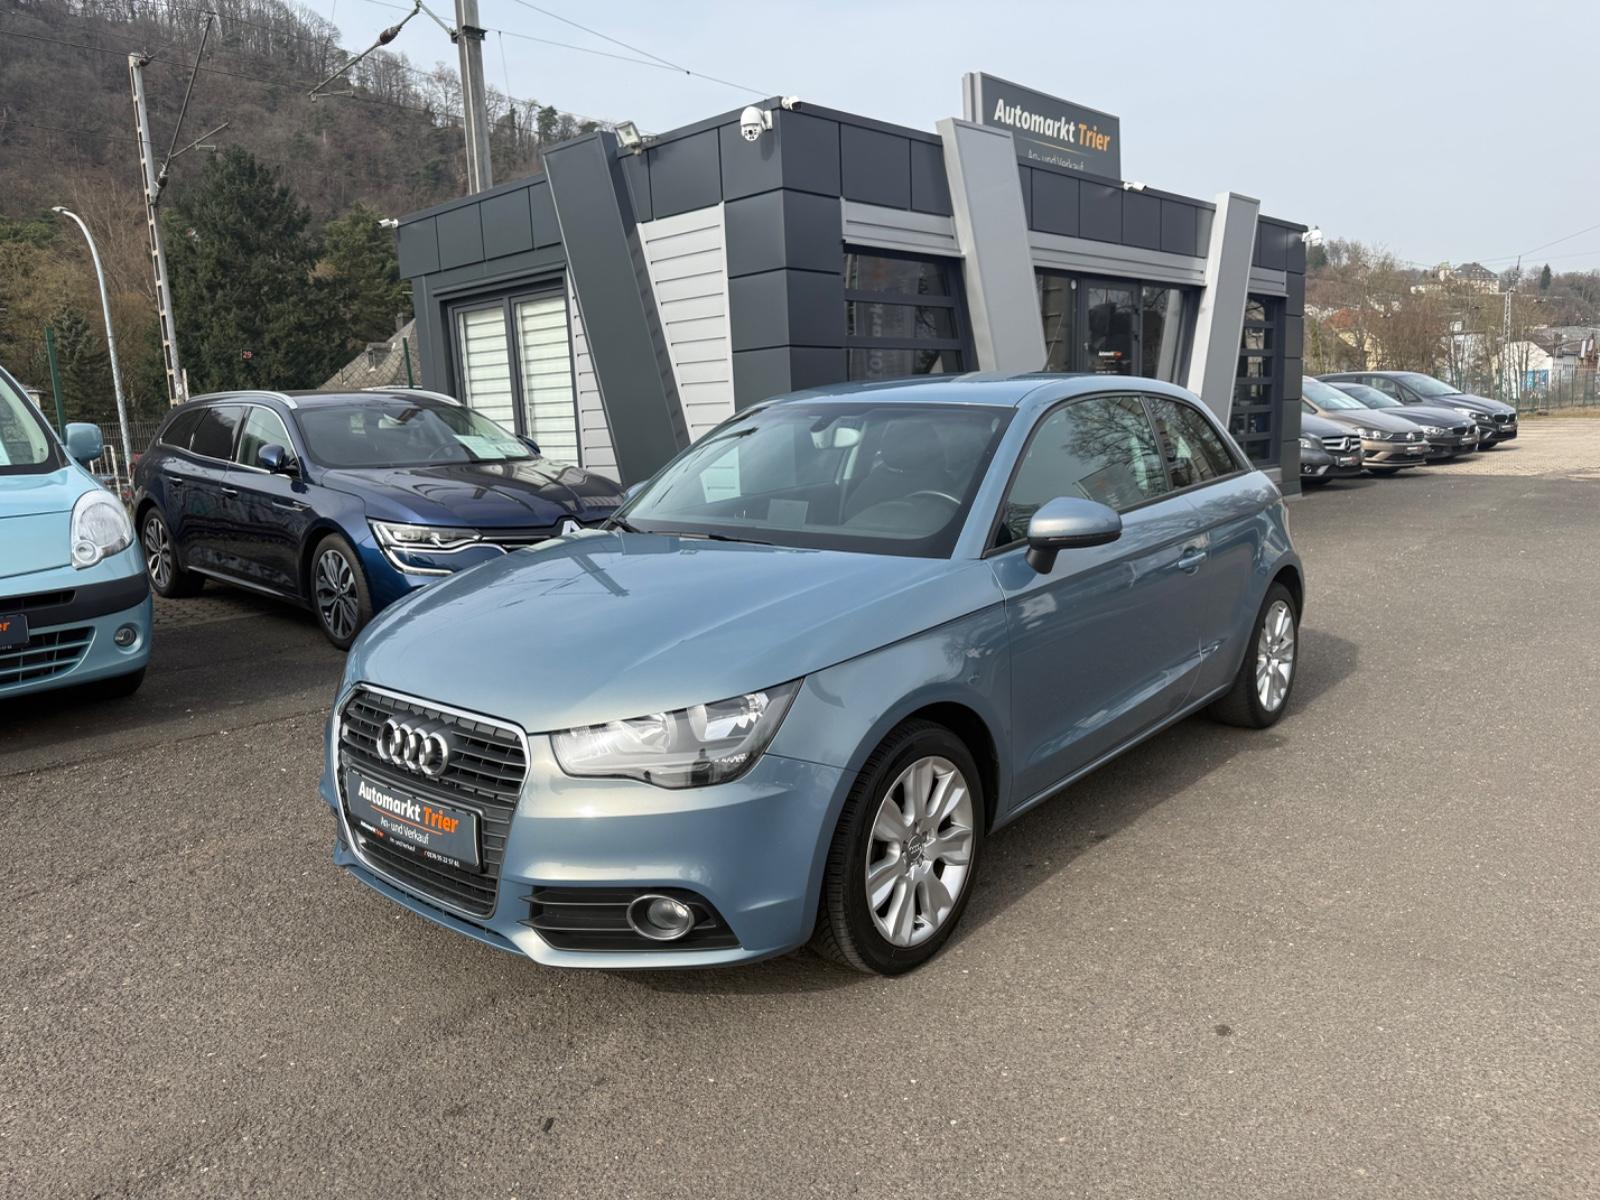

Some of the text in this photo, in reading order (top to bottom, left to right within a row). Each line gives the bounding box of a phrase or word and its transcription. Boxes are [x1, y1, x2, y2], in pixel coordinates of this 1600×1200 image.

[993, 98, 1111, 152] Automarkt Trier
[358, 781, 421, 822] Automarkt
[422, 805, 459, 833] Trier
[380, 815, 391, 829] An-
[390, 823, 403, 835] und
[403, 825, 429, 845] Verkauf
